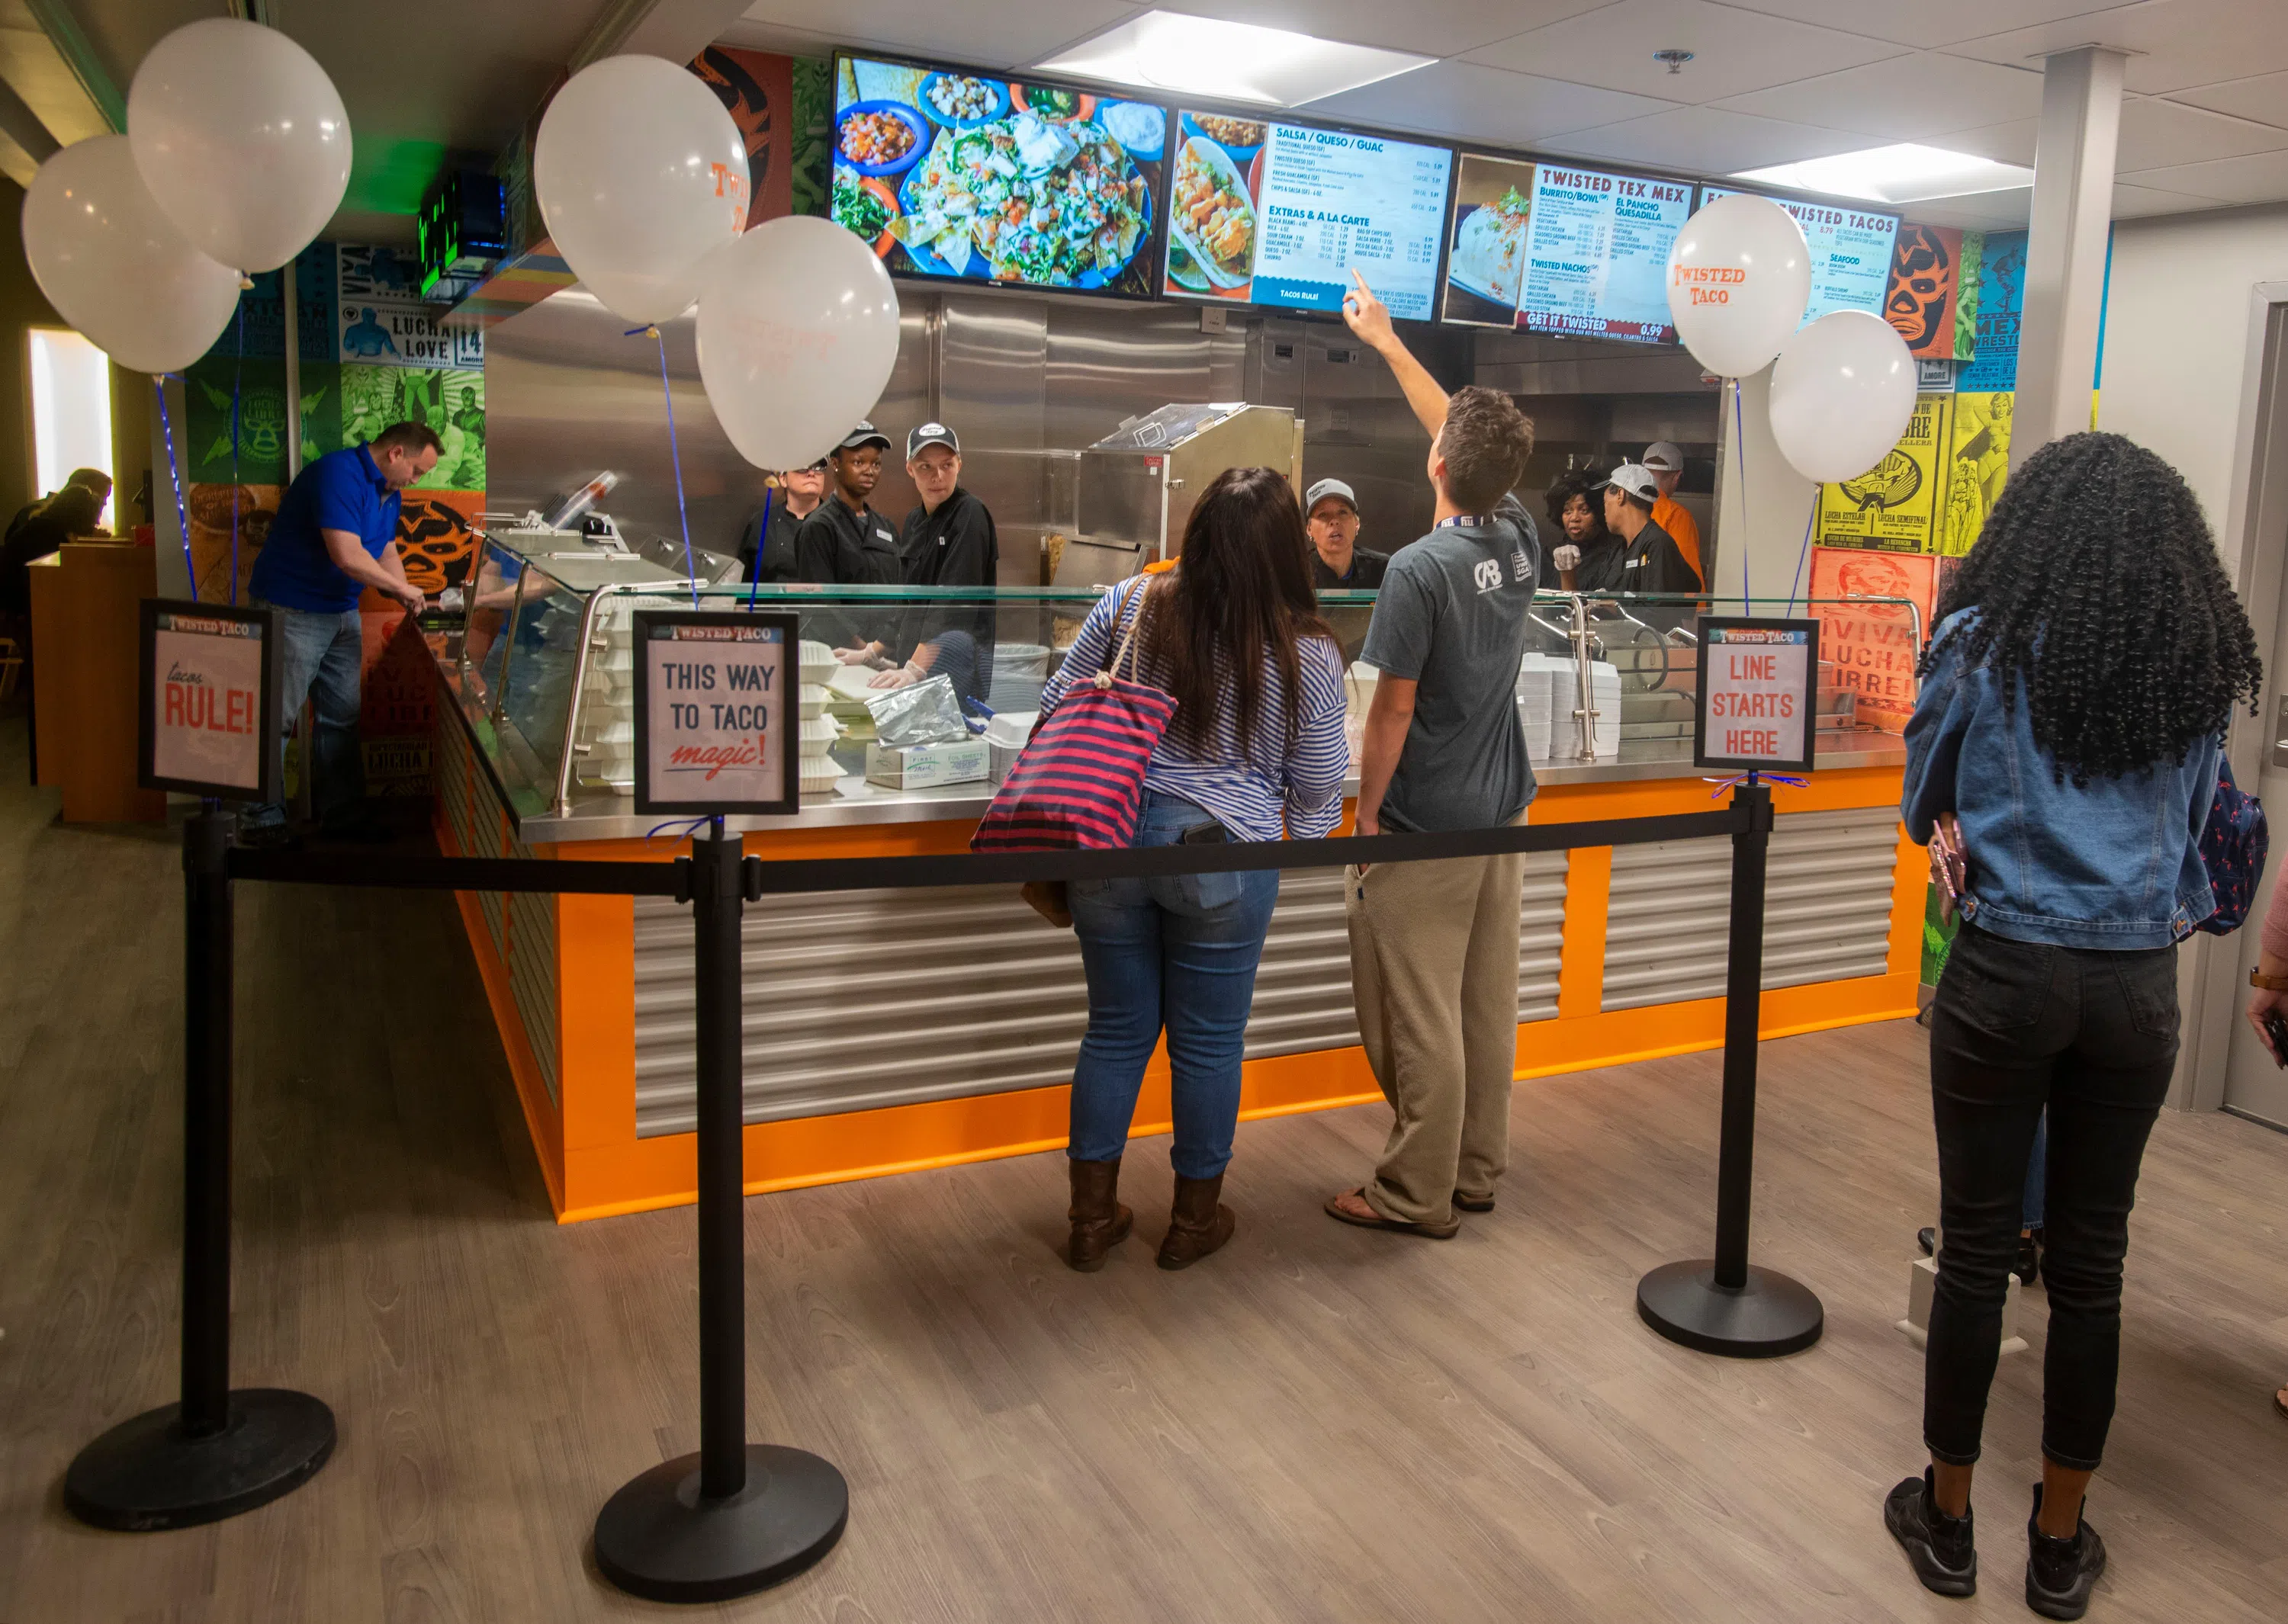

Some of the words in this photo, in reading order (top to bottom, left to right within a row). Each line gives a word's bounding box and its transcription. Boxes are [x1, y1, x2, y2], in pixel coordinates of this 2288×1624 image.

[1276, 140, 1303, 149] TRADITIONAL
[1277, 128, 1306, 141] SALSA
[1316, 133, 1348, 146] QUESO
[1357, 140, 1383, 152] GUAC
[1287, 172, 1310, 180] GUACAMOLE
[1540, 186, 1599, 204] BURRITO/BOWL
[1543, 169, 1612, 192] TWISTED
[1618, 180, 1647, 197] TEX
[1651, 185, 1685, 204] MEX
[1615, 207, 1662, 221] QUESADILLA
[1616, 197, 1624, 207] EL
[1627, 199, 1659, 211] PANCHO
[1269, 205, 1305, 218] EXTRAS
[1307, 210, 1314, 220] &
[1317, 211, 1325, 221] A
[1327, 213, 1338, 223] LA
[1341, 214, 1370, 226] CARTE
[1779, 204, 1843, 225] WISTED
[1849, 214, 1894, 233] TACOS
[1266, 239, 1290, 248] GUACAMOLE
[1531, 258, 1560, 270] TWISTED
[1561, 262, 1590, 274] NACHOS
[1830, 253, 1860, 265] SEAFOOD
[1674, 265, 1746, 286] TWISTED
[1281, 290, 1300, 298] TACOS
[1301, 292, 1319, 300] RULE!
[1690, 287, 1729, 305] TACO
[393, 316, 450, 338] LUCHA
[1527, 313, 1548, 326] GET
[1549, 315, 1560, 326] IT
[1562, 316, 1607, 331] TWISTED
[1640, 324, 1663, 337] 0.99
[406, 340, 448, 360] LOVE
[1924, 371, 1946, 380] AMORE
[1921, 403, 1932, 415] DE
[1825, 511, 1841, 520] LUCHA
[1842, 512, 1866, 521] ESTELAR
[1878, 514, 1896, 523] LUCHA
[1897, 515, 1927, 525] SEMIFINAL
[1516, 566, 1530, 576] SGA
[169, 616, 218, 634] TWISTED
[220, 622, 249, 636] TACO
[670, 625, 732, 640] TWISTED
[734, 627, 772, 642] TACO
[1720, 630, 1765, 644] TWISTED
[1766, 631, 1794, 644] TACO
[1730, 655, 1776, 680] LINE
[1820, 643, 1914, 673] LUCHA
[167, 661, 204, 684] tacos
[662, 663, 715, 690] THIS
[727, 665, 775, 692] WAY
[1837, 669, 1911, 698] IBRE!
[165, 682, 254, 735] RULE!
[1713, 692, 1793, 718] STARTS
[670, 703, 699, 730] TO
[710, 704, 767, 730] TACO
[1727, 730, 1778, 755] HERE
[670, 733, 766, 782] magic!
